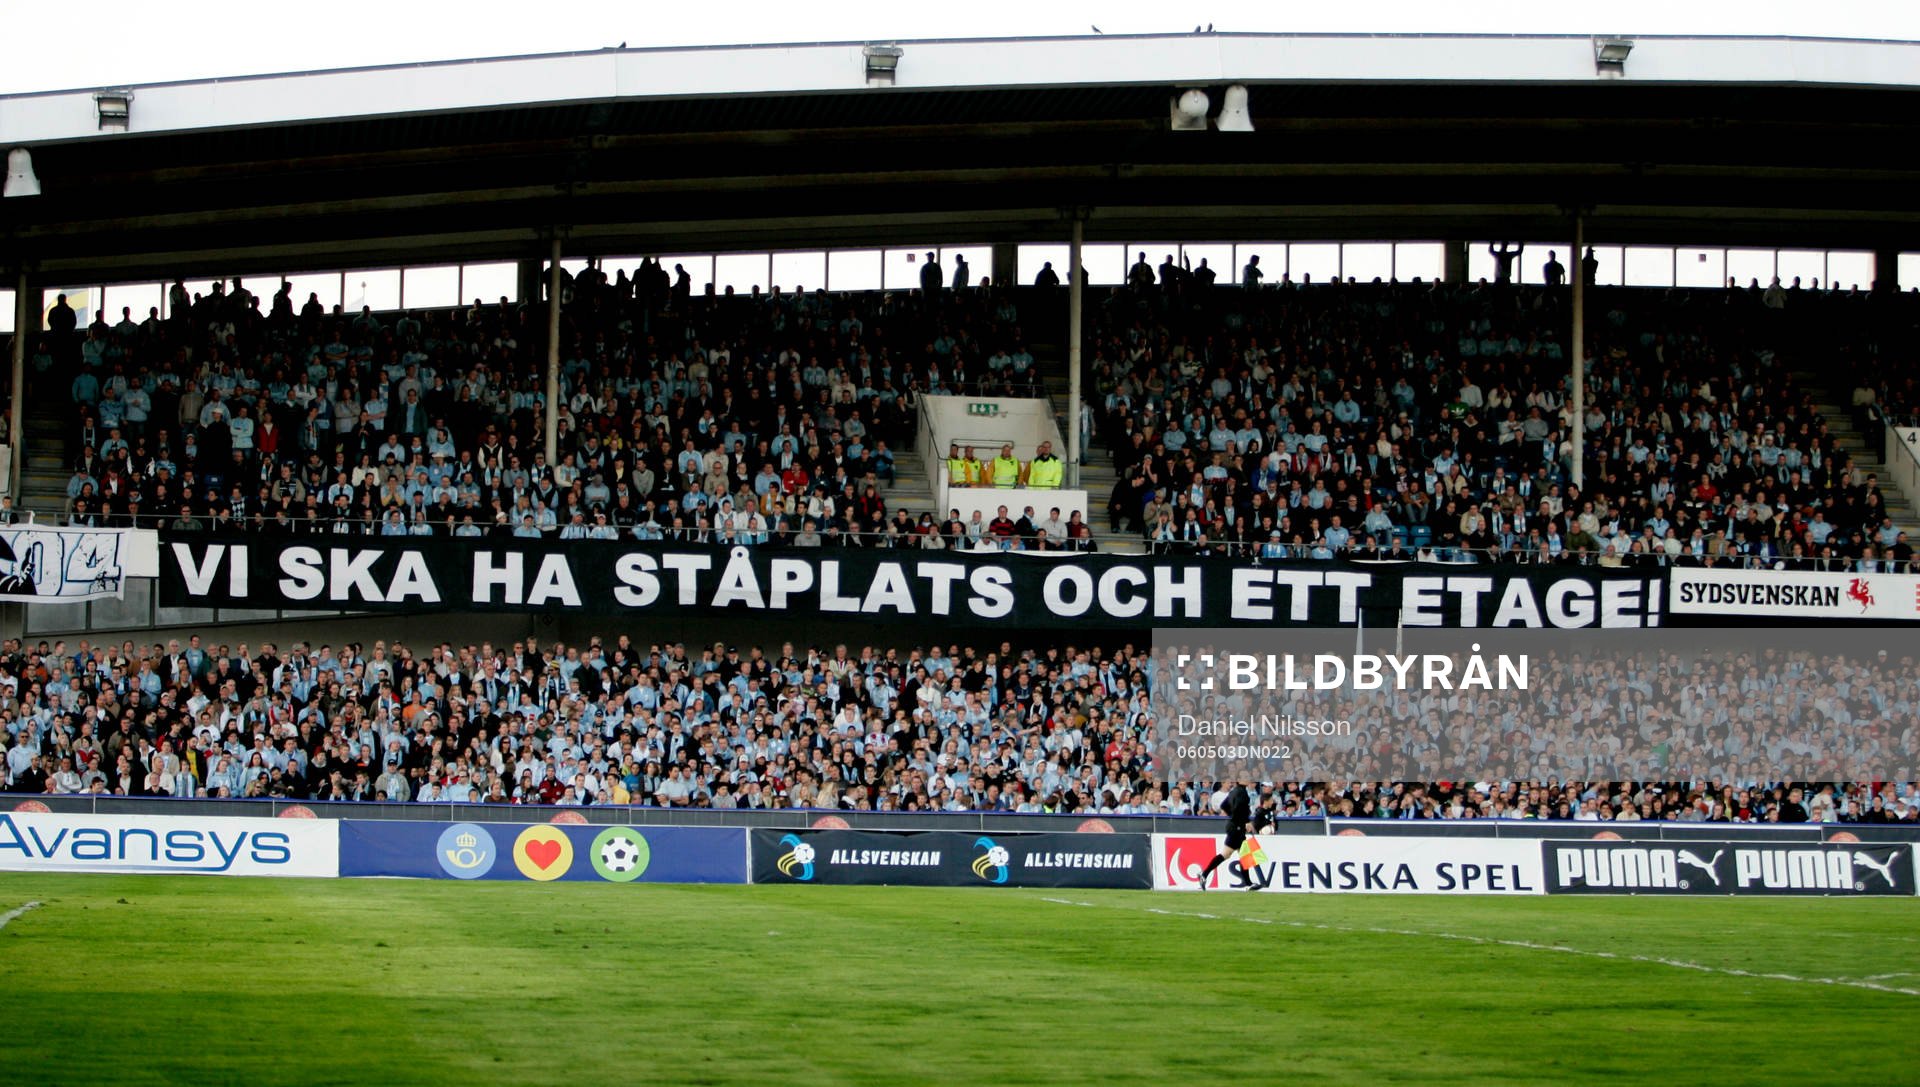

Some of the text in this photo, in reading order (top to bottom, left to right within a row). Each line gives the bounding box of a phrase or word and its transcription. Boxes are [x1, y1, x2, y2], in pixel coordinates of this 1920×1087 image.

[1907, 431, 1917, 445] 4
[171, 543, 1661, 629] VI SKA HA STÅPLATS OCH ETT ETAGE!
[1680, 581, 1840, 607] SYDSVENSKAN
[0, 813, 291, 872] Avansys
[830, 849, 941, 866] ALLSVENSKAN
[1024, 852, 1134, 869] ALLSVENSKAN
[1228, 860, 1533, 891] SVENSKA SPEL
[1556, 848, 1678, 888] PUMA
[1735, 849, 1854, 889] PUMA
